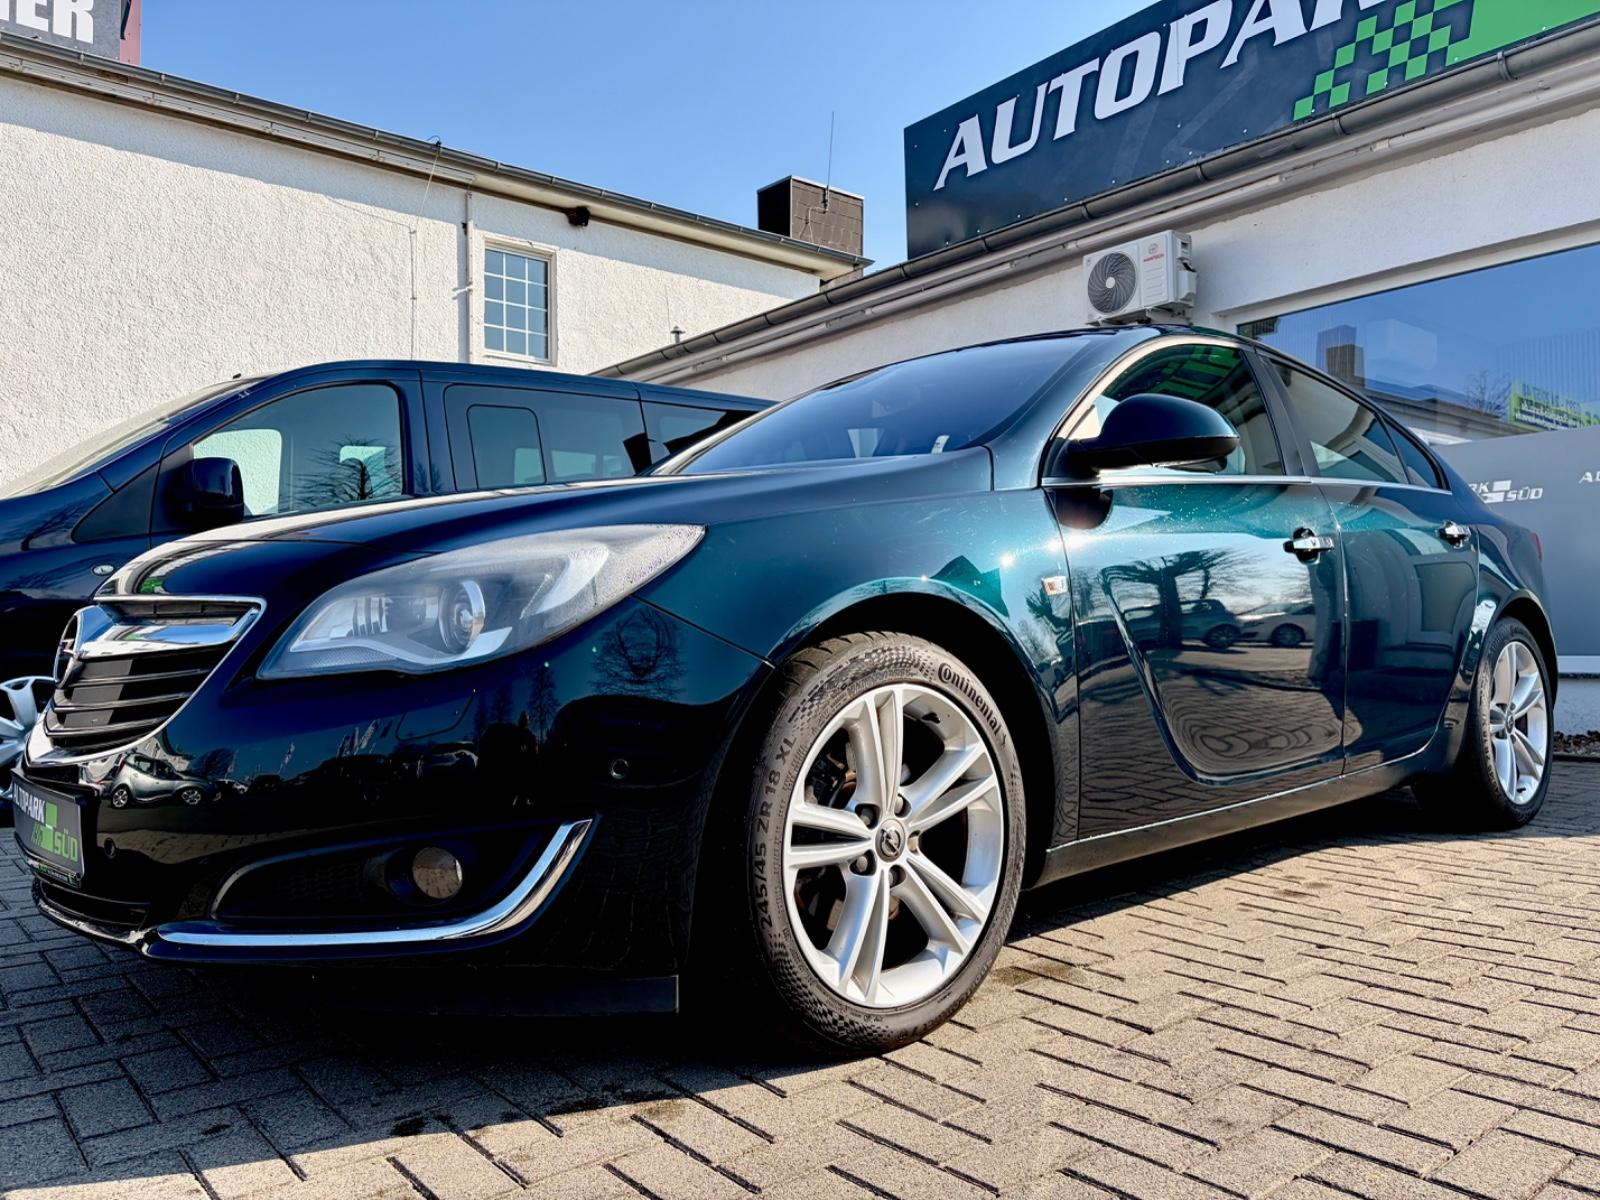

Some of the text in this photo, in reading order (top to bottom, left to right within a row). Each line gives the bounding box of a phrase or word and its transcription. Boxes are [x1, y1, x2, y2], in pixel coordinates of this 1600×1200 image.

[1506, 486, 1544, 502] SÜD
[938, 662, 1002, 736] Continental
[54, 827, 78, 862] SÜD
[754, 842, 773, 930] 245/45
[776, 735, 797, 764] XL
